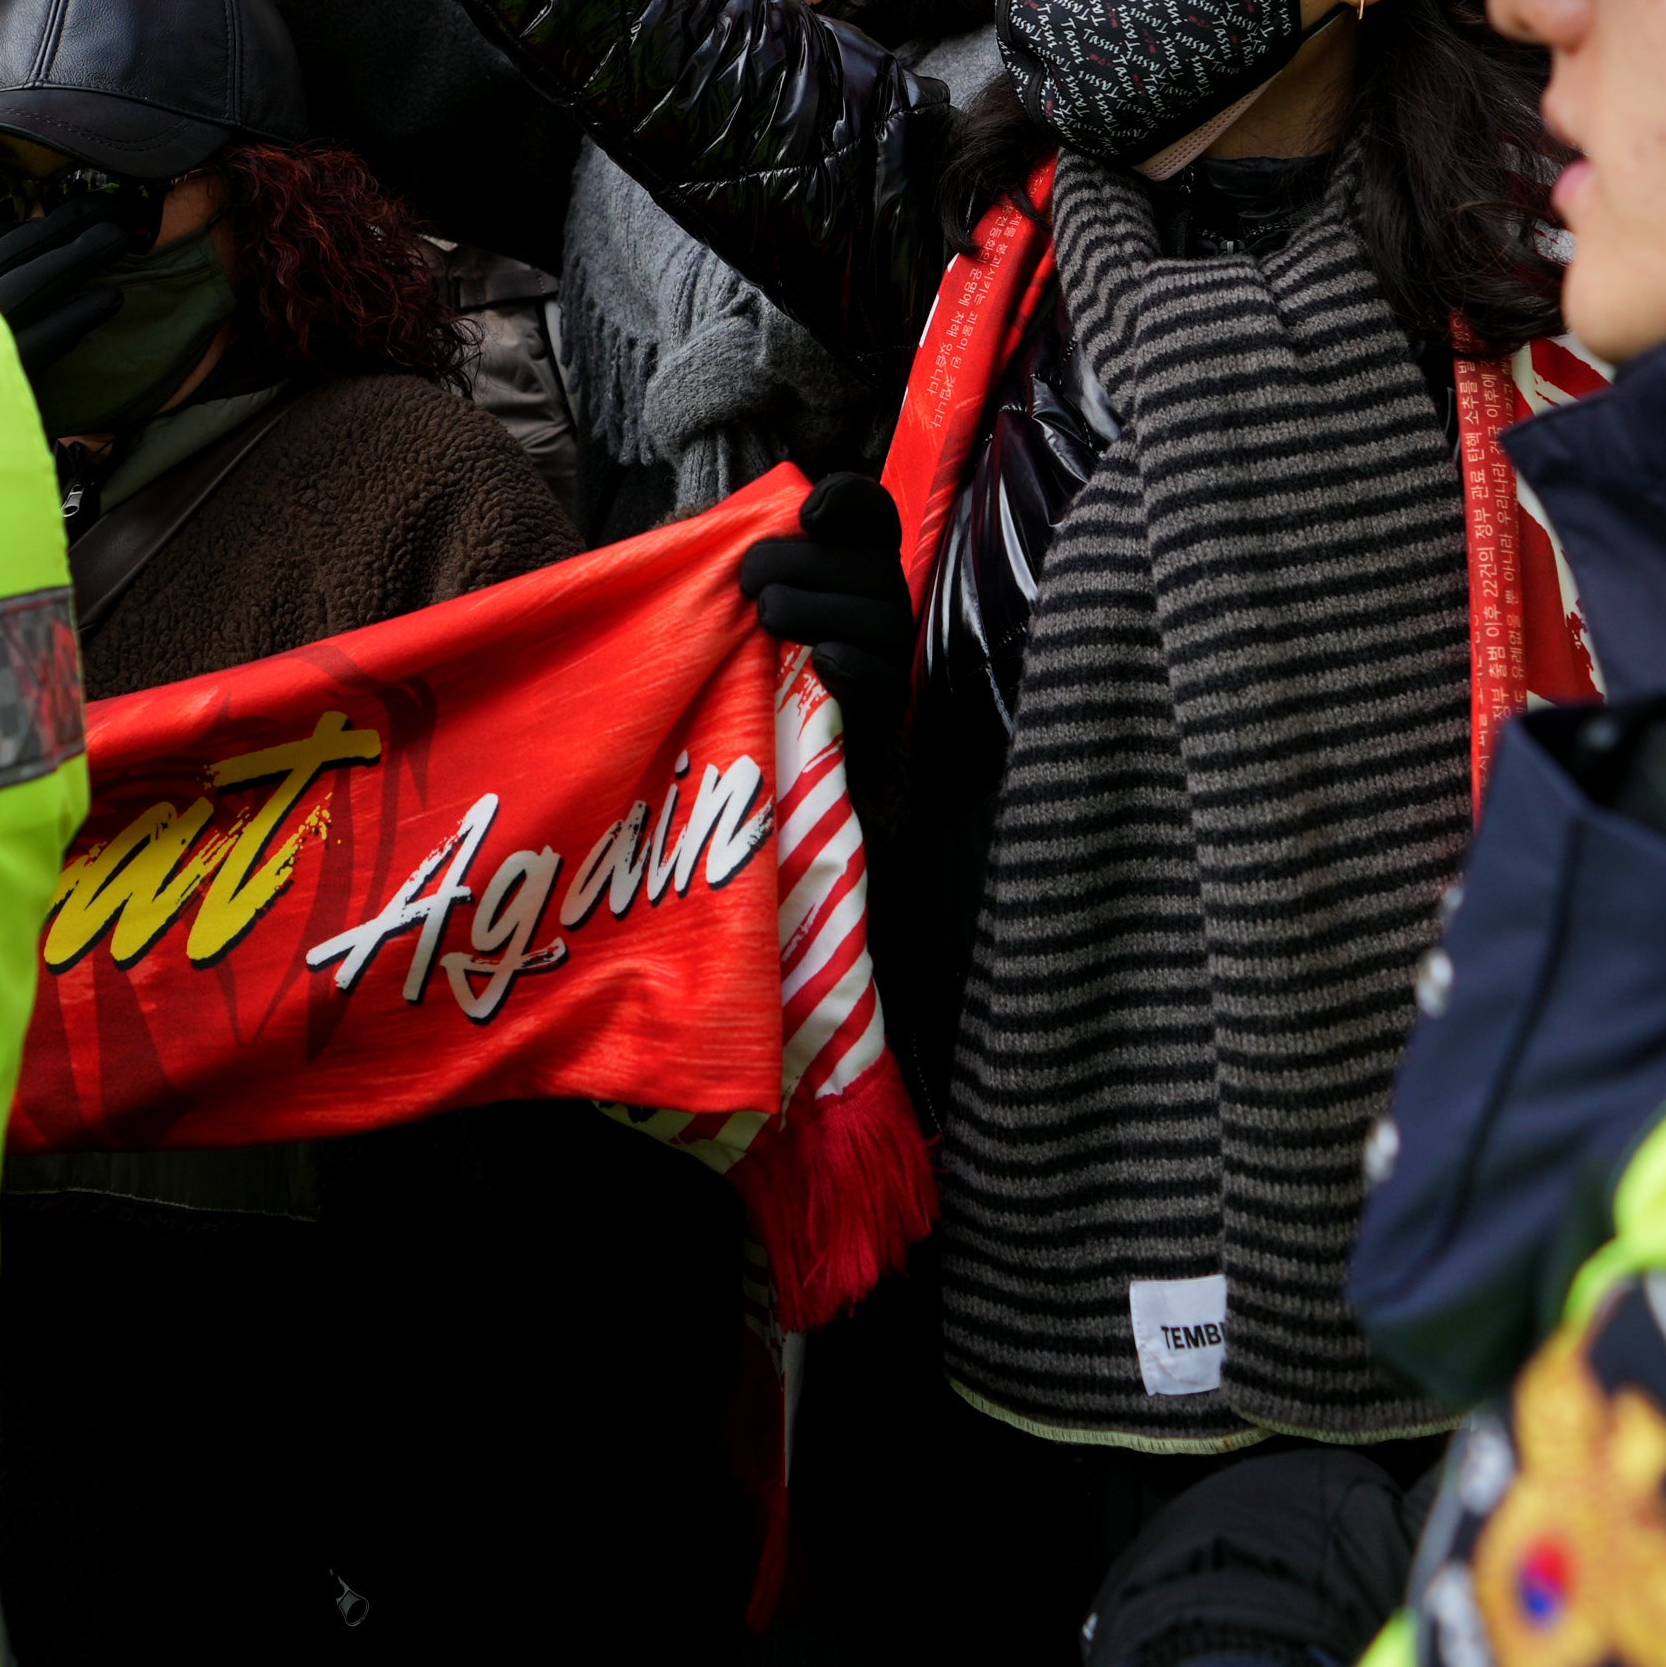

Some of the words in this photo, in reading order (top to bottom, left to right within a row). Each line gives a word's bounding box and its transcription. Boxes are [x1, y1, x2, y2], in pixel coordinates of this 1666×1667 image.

[958, 267, 983, 306] 운명에
[974, 243, 1009, 306] 붕괴시키는
[946, 311, 965, 337] 처해
[956, 311, 979, 350] 괴물이
[924, 341, 954, 397] 있습니다.
[949, 357, 963, 370] 된
[929, 375, 956, 430] 것입니다.
[1460, 380, 1481, 425] 소추를
[1481, 373, 1501, 418] 이후에
[1465, 431, 1486, 462] 탄핵
[1469, 468, 1489, 500] 관료
[1490, 462, 1513, 525] 우리나라
[1472, 507, 1494, 539] 정부
[1476, 546, 1500, 597] 22건의
[1499, 533, 1517, 581] 아니라
[1482, 604, 1503, 637] 이후
[1485, 645, 1508, 679] 출범
[1490, 686, 1511, 720] 정부
[307, 751, 775, 1024] Again
